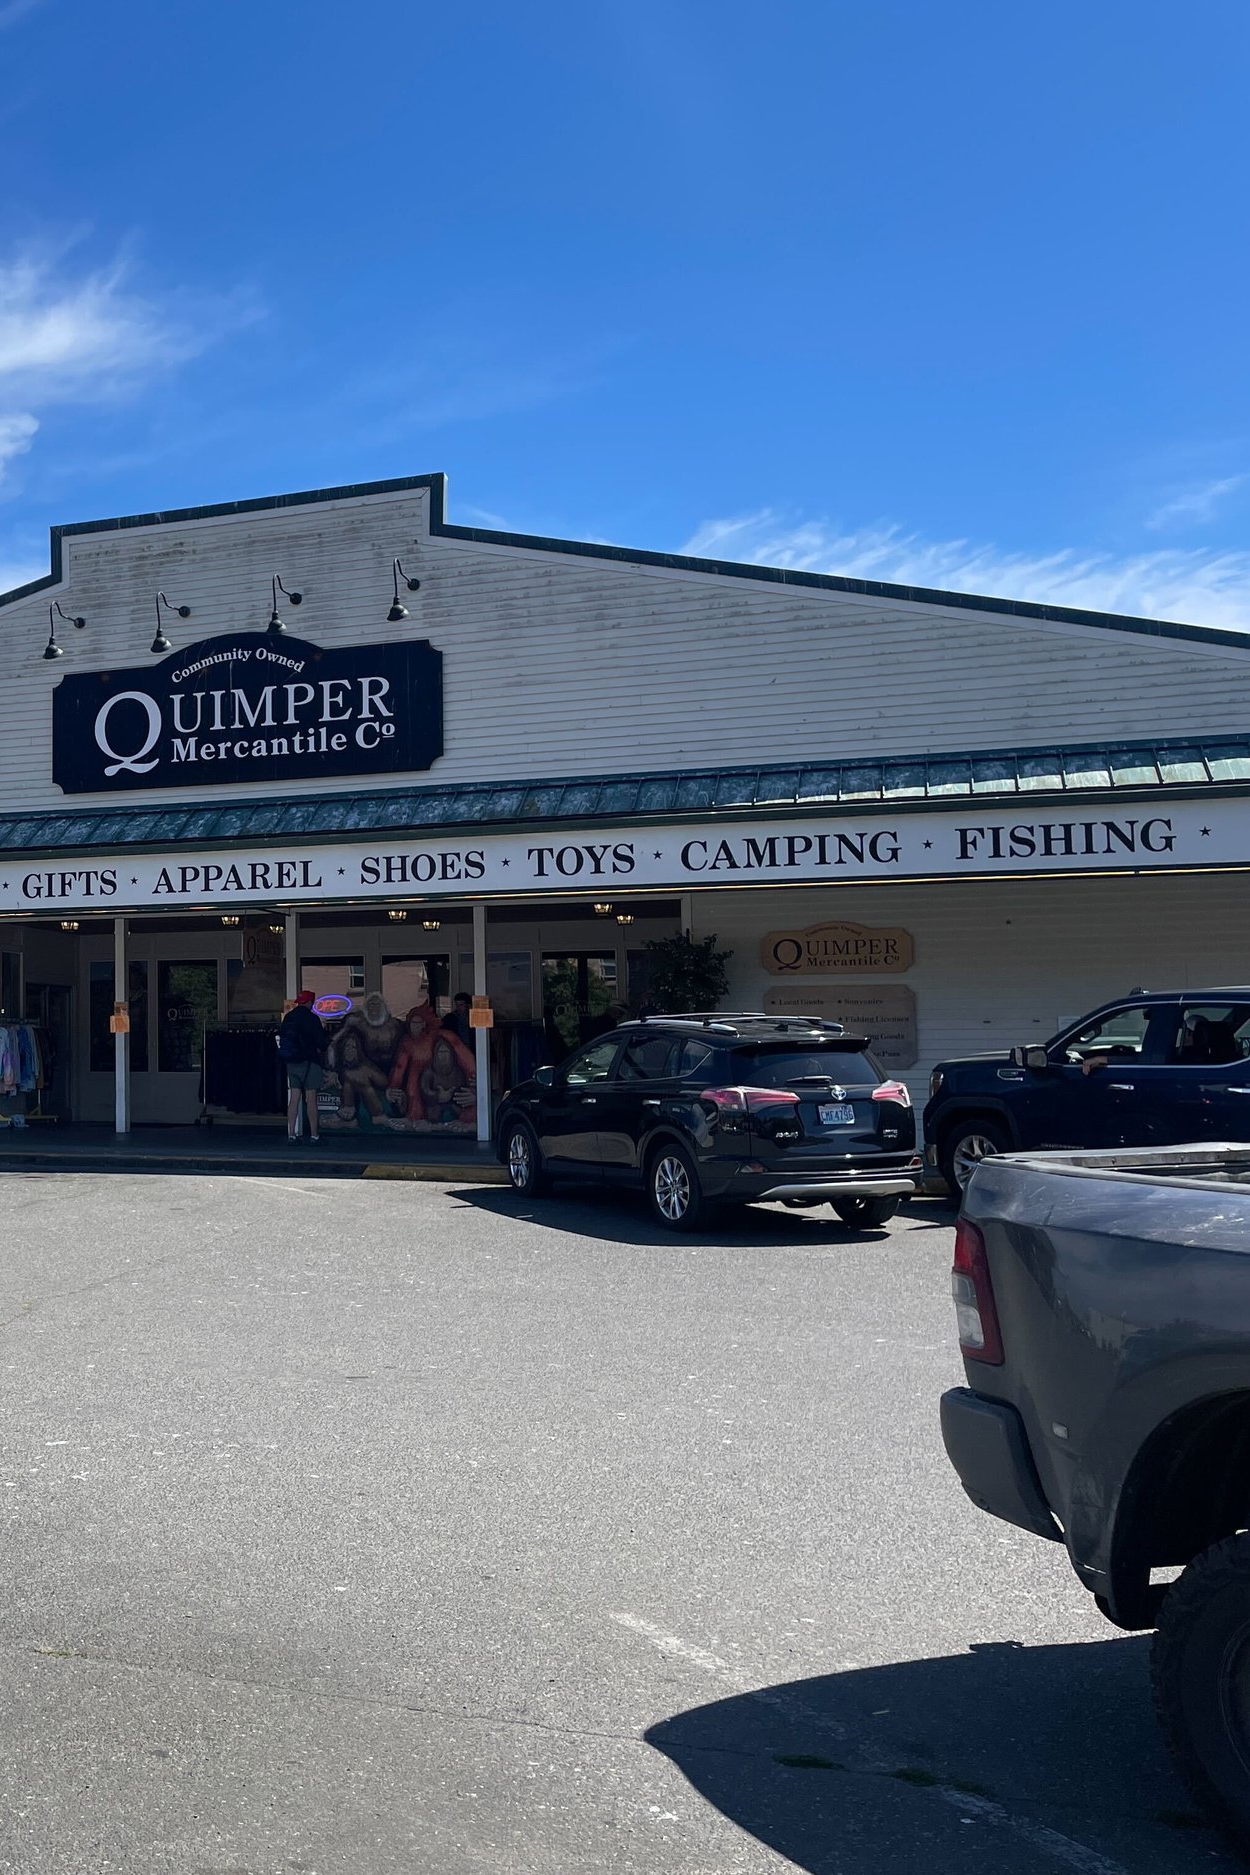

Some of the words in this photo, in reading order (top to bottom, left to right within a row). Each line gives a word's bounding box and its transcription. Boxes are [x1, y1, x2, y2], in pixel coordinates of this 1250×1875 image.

[171, 647, 252, 684] Community
[255, 647, 306, 673] Owned
[94, 676, 394, 777] QUIMPER
[171, 726, 347, 764] Mercantile
[21, 869, 117, 899] GIFTS
[151, 860, 322, 894] APPAREL
[360, 850, 486, 885] SHOES
[527, 842, 635, 878] TOYS
[680, 830, 902, 872] CAMPING
[955, 818, 1178, 861] FISHING
[773, 938, 899, 970] QUIMPER
[806, 955, 881, 967] Mercantile
